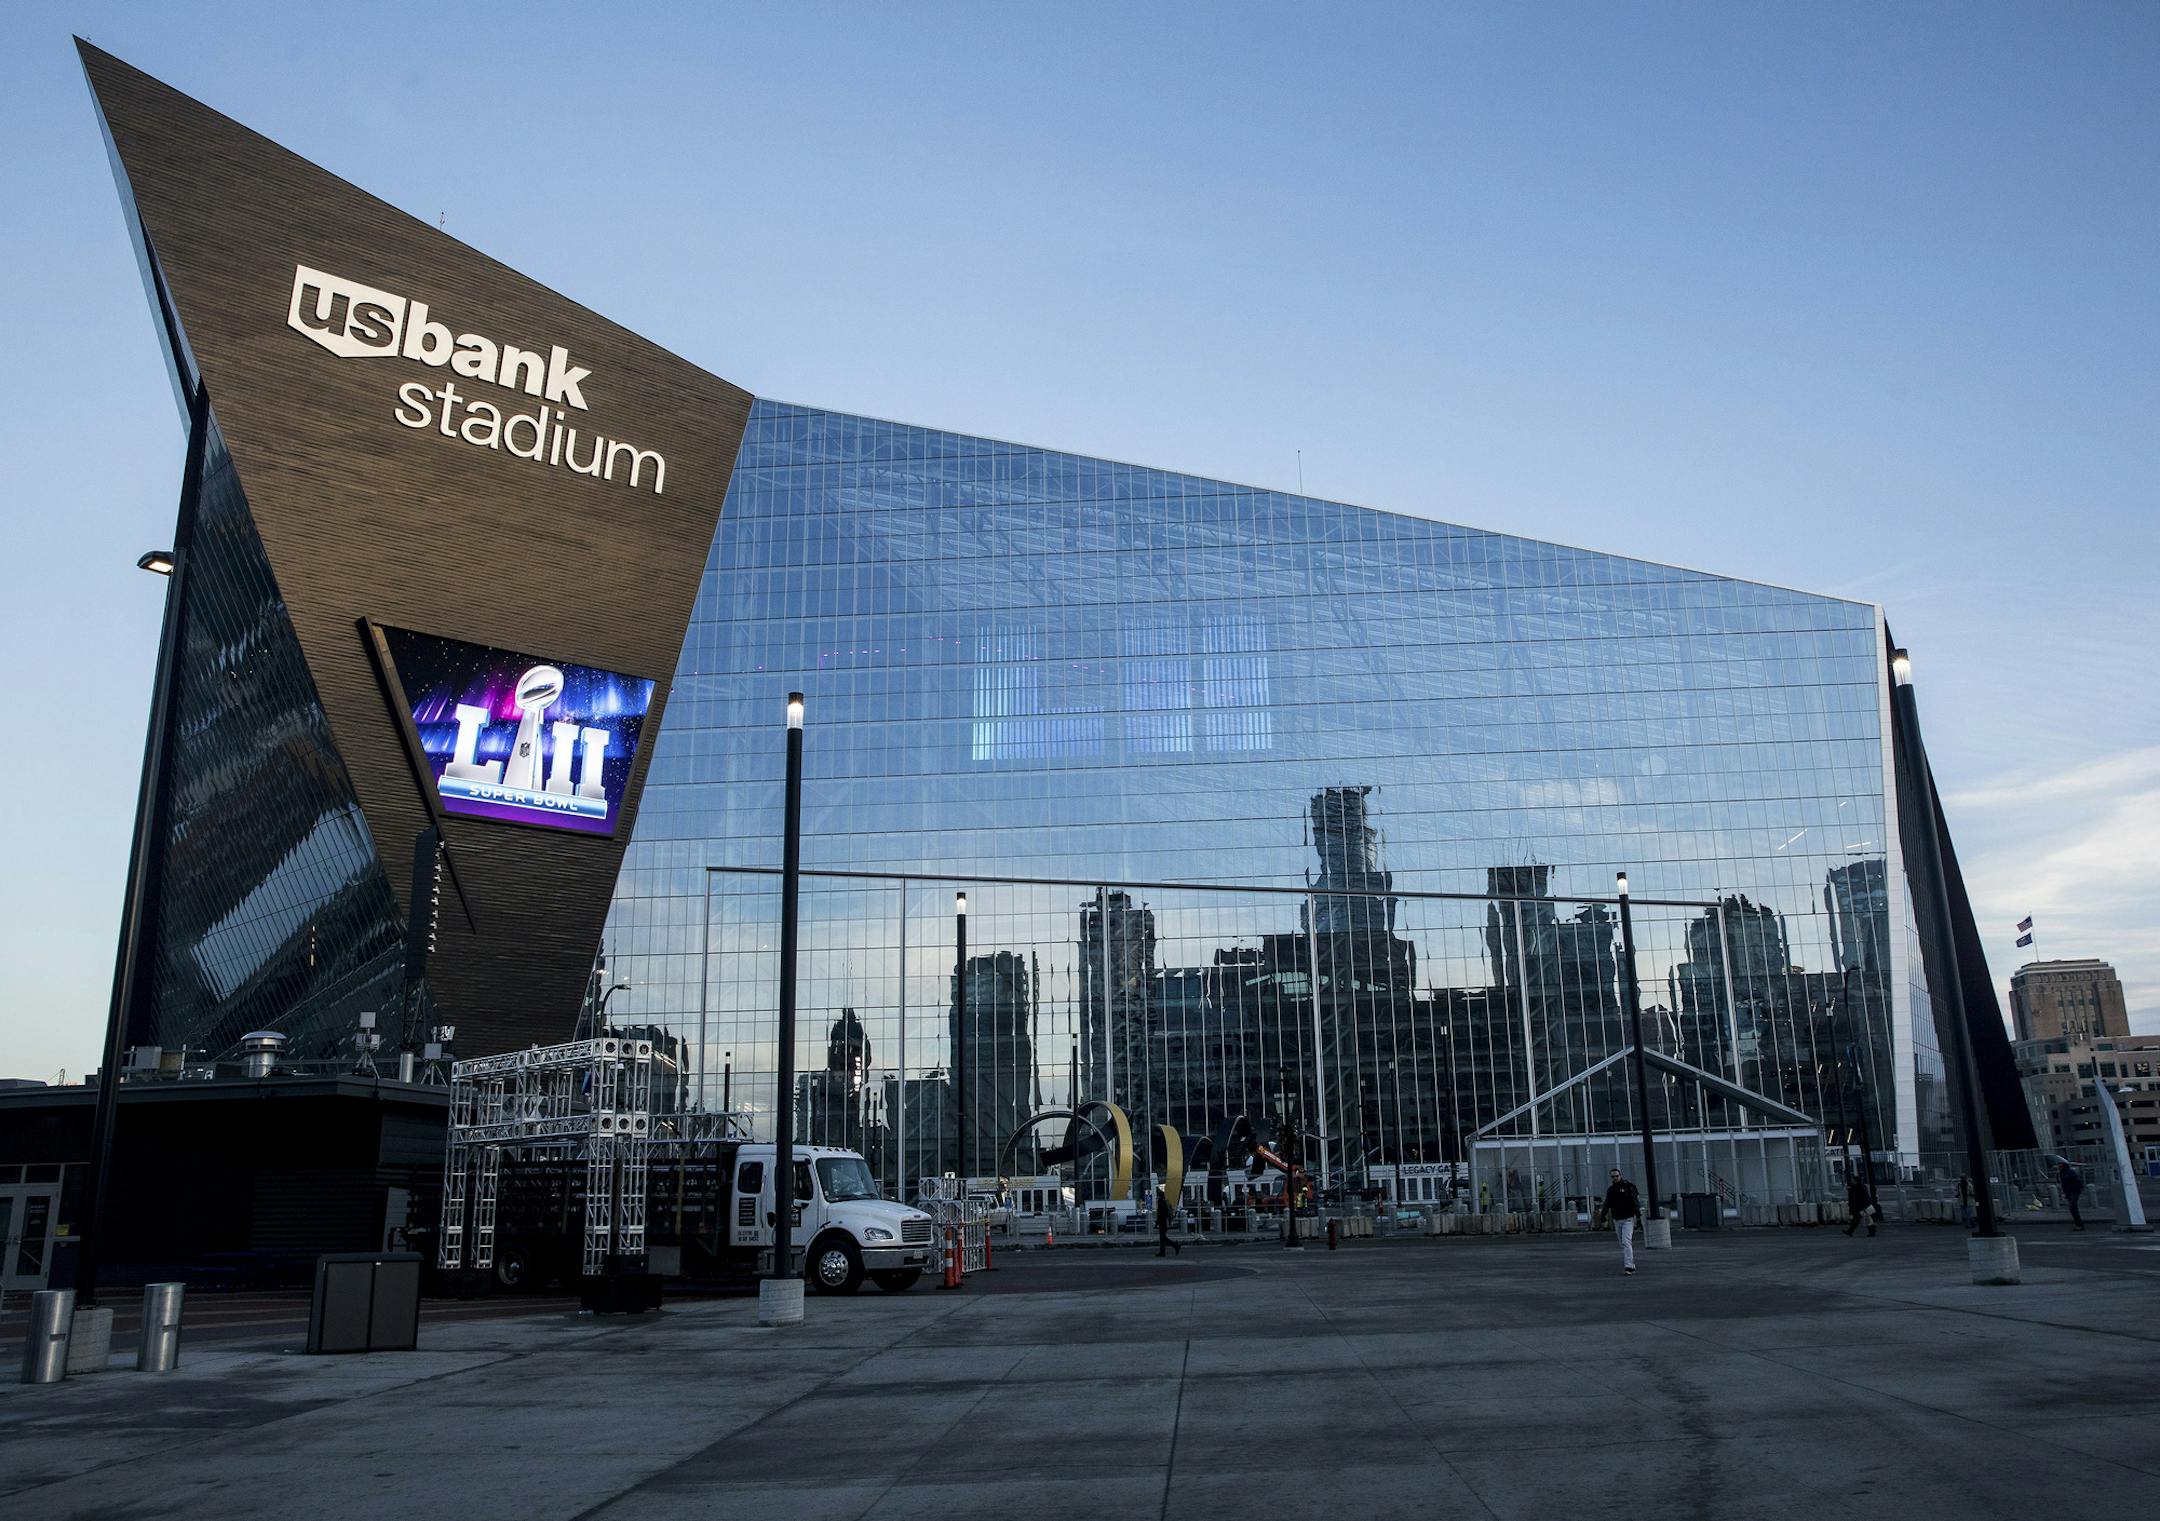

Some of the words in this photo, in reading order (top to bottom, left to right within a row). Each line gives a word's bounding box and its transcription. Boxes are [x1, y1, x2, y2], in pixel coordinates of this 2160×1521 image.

[393, 382, 665, 494] stadium
[470, 784, 526, 803] SUPER
[533, 795, 578, 811] BOWL
[1403, 1165, 1436, 1174] LEGACY
[1438, 1164, 1460, 1173] GAE
